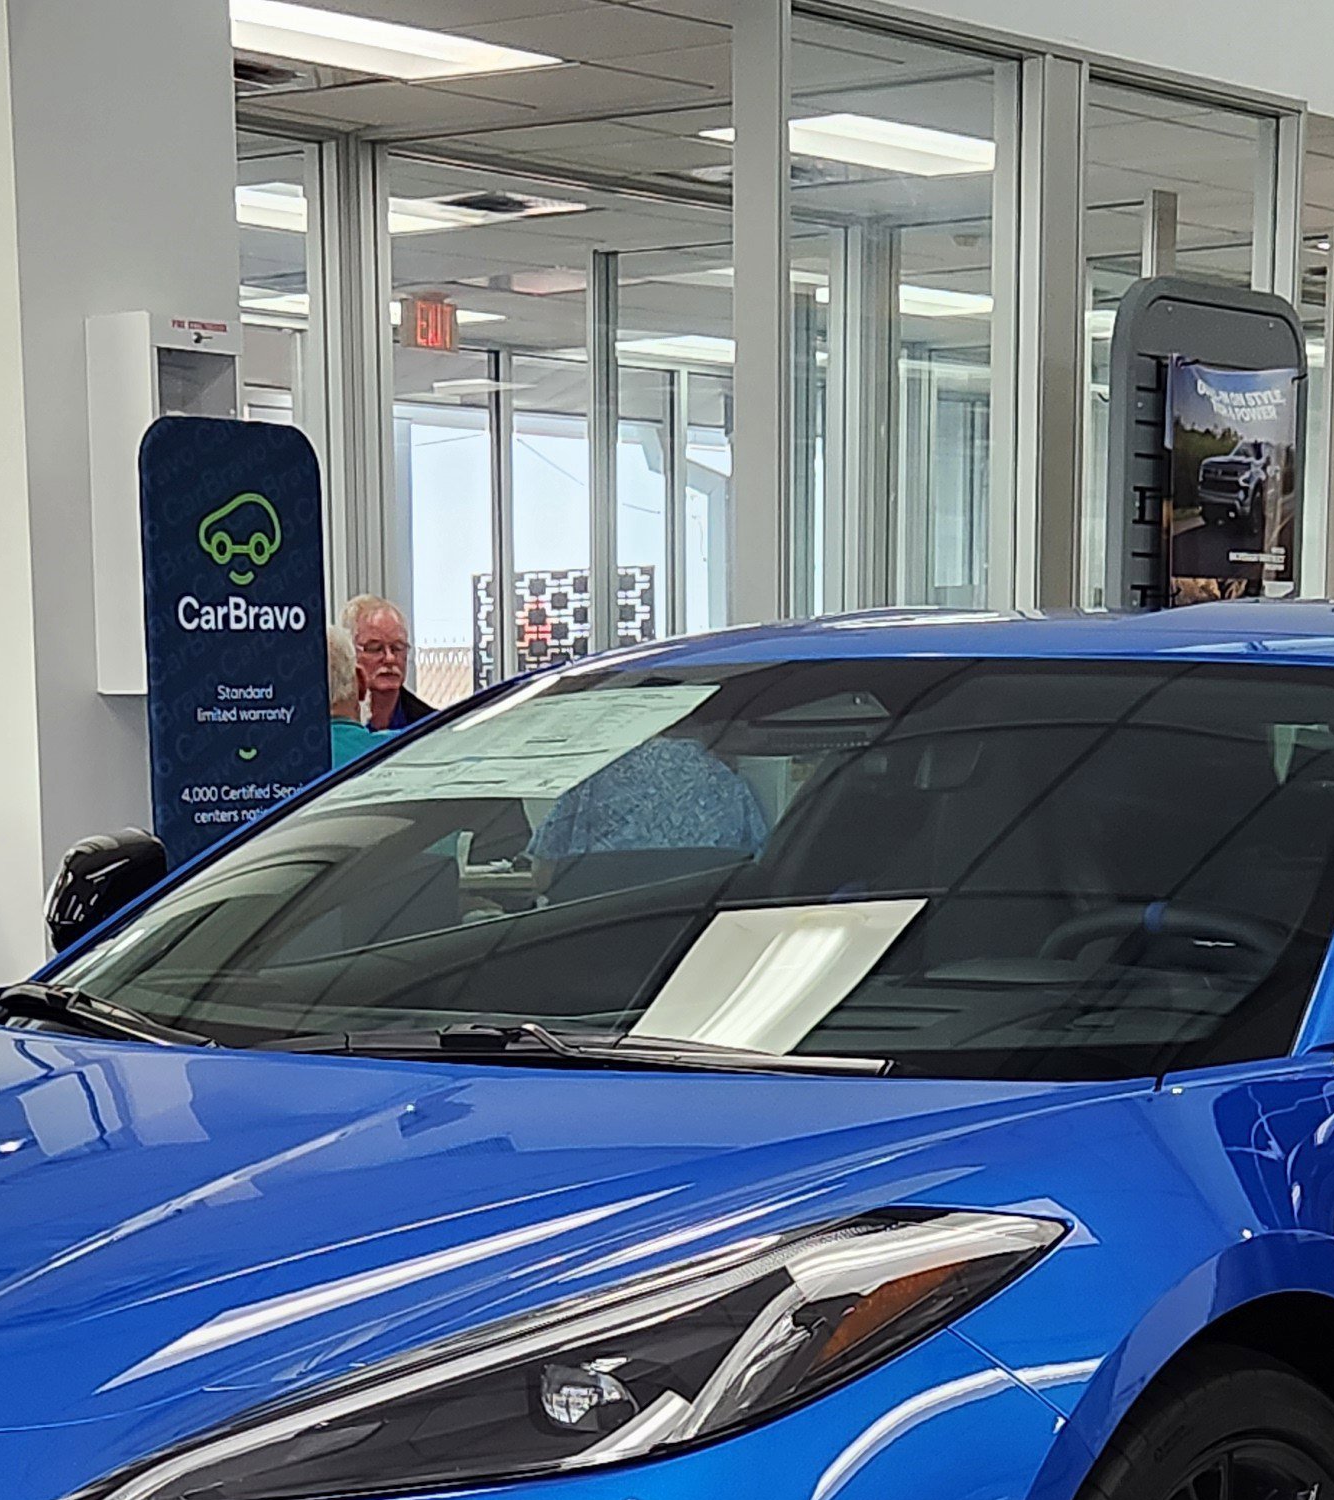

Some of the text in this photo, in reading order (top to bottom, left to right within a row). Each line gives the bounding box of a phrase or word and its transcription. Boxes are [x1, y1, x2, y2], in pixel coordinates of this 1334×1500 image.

[177, 595, 306, 631] CarBravo
[217, 685, 273, 700] Standard
[196, 706, 295, 724] limited warranty
[181, 786, 218, 804] 4,000
[221, 784, 270, 801] Certified
[194, 808, 239, 824] centers
